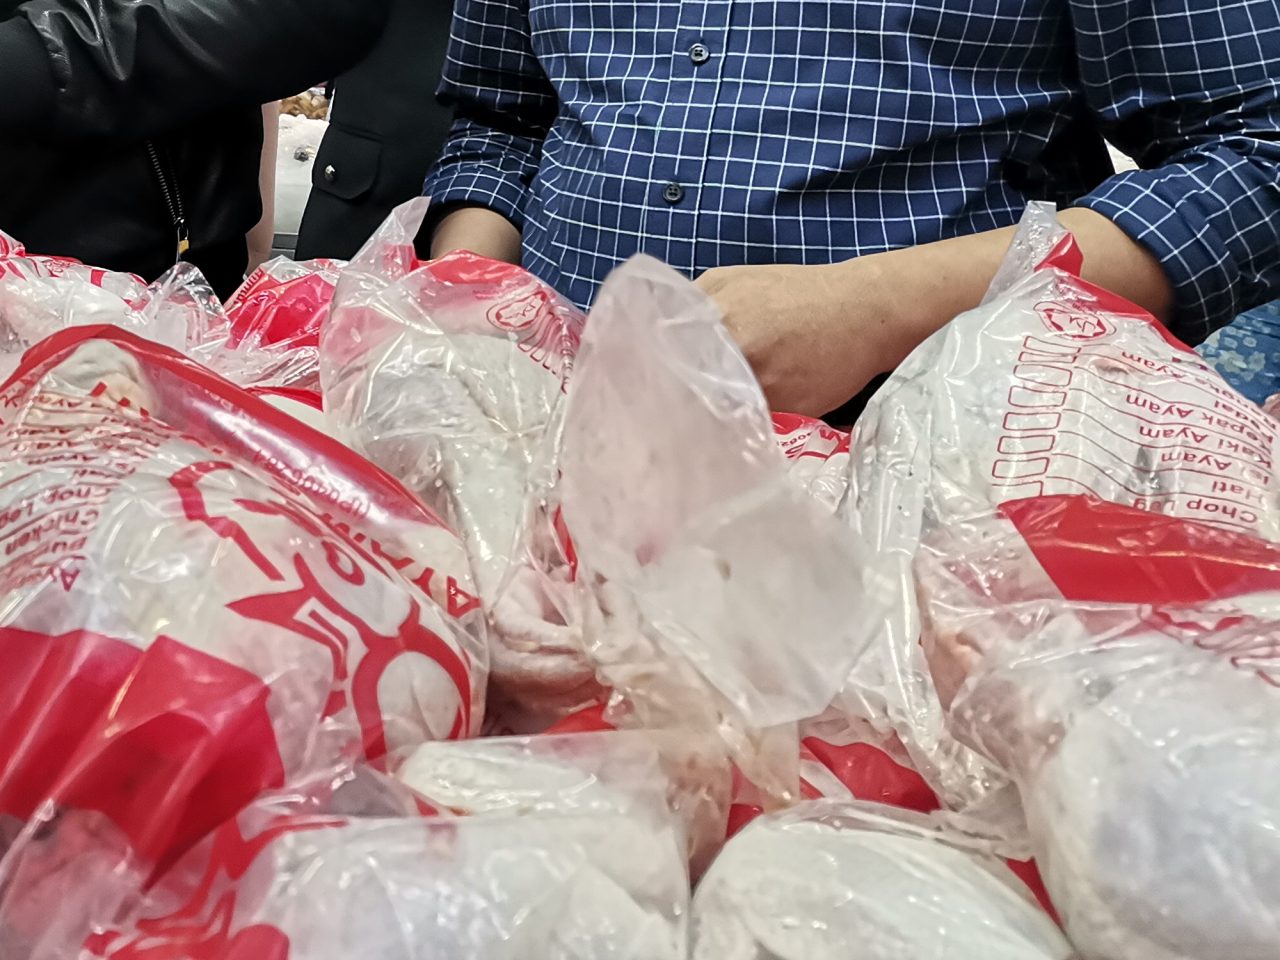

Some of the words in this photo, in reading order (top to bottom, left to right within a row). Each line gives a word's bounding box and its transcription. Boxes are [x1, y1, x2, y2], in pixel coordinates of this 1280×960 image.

[1125, 394, 1194, 419] Ayam
[1138, 426, 1208, 444] Ayam
[1161, 449, 1232, 471] Ayam
[1217, 439, 1273, 469] Kaki
[1186, 499, 1258, 523] Chop
